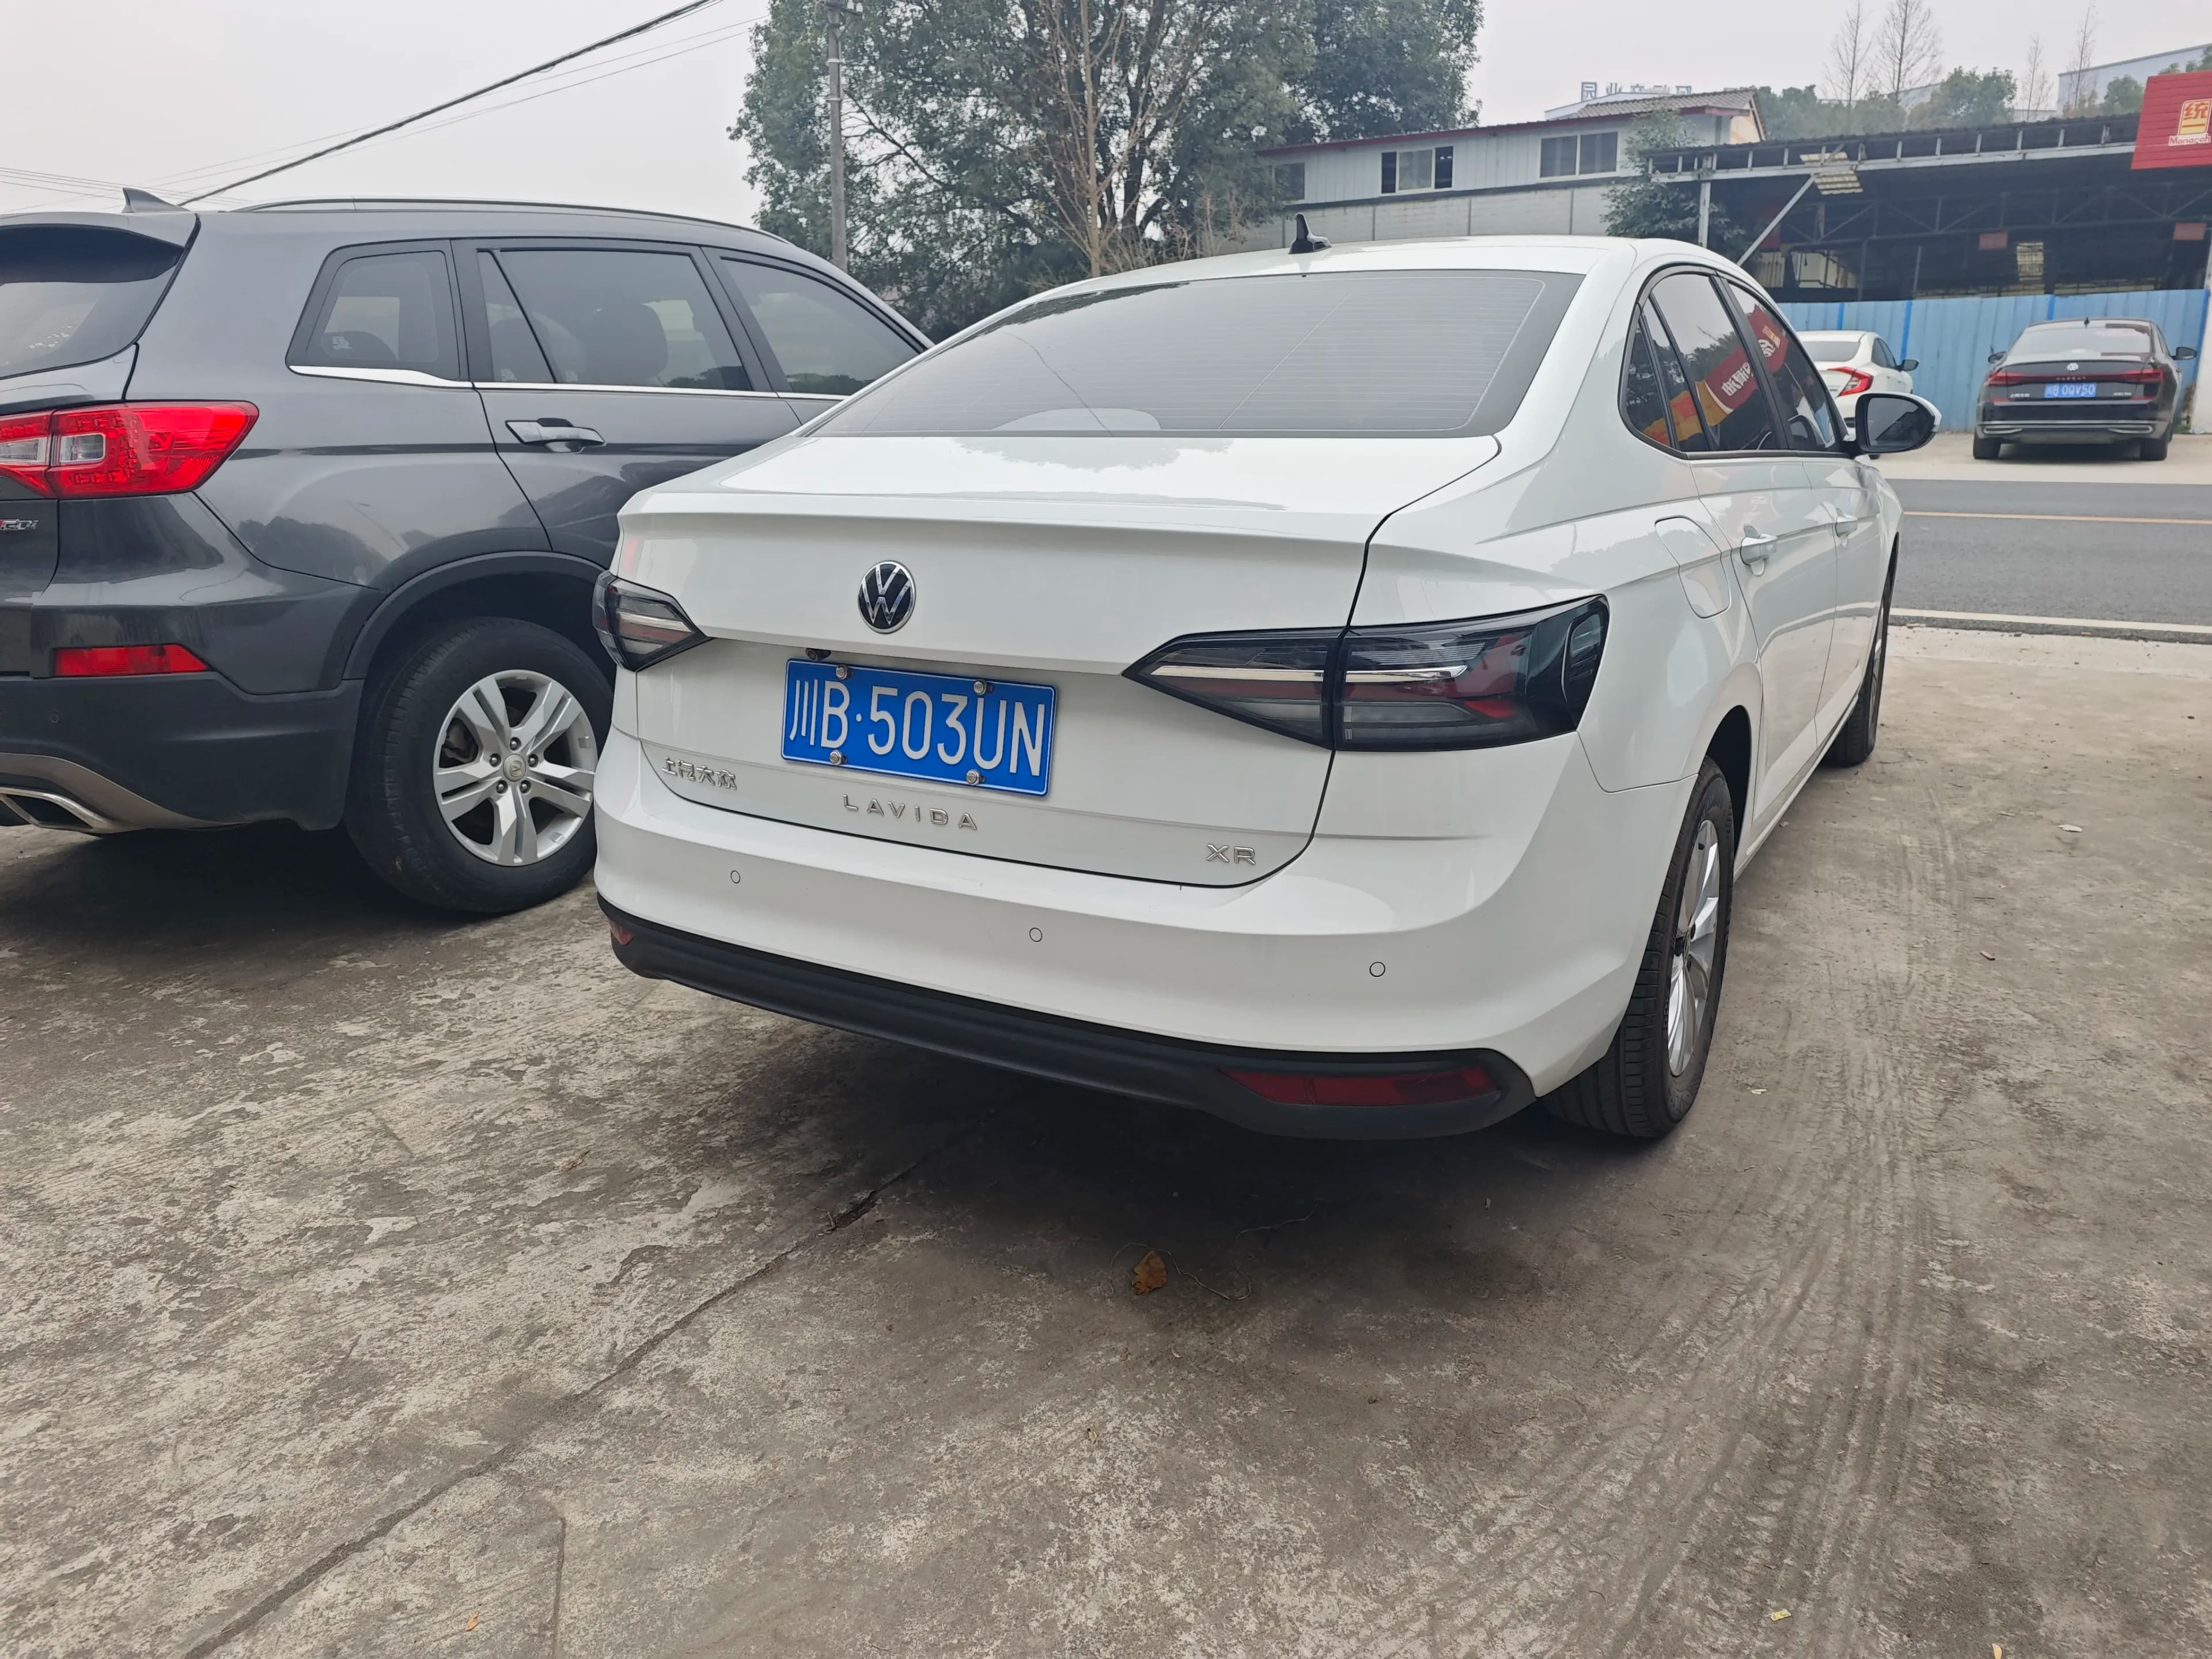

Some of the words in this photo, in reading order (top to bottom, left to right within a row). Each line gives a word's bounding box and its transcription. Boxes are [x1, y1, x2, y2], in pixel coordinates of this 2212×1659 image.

[2182, 103, 2209, 127] 统一
[2171, 135, 2210, 143] Monarch
[0, 519, 39, 530] GDI
[661, 756, 737, 790] 上汽大众
[843, 794, 978, 831] LAVIDA
[1206, 843, 1256, 865] XR
